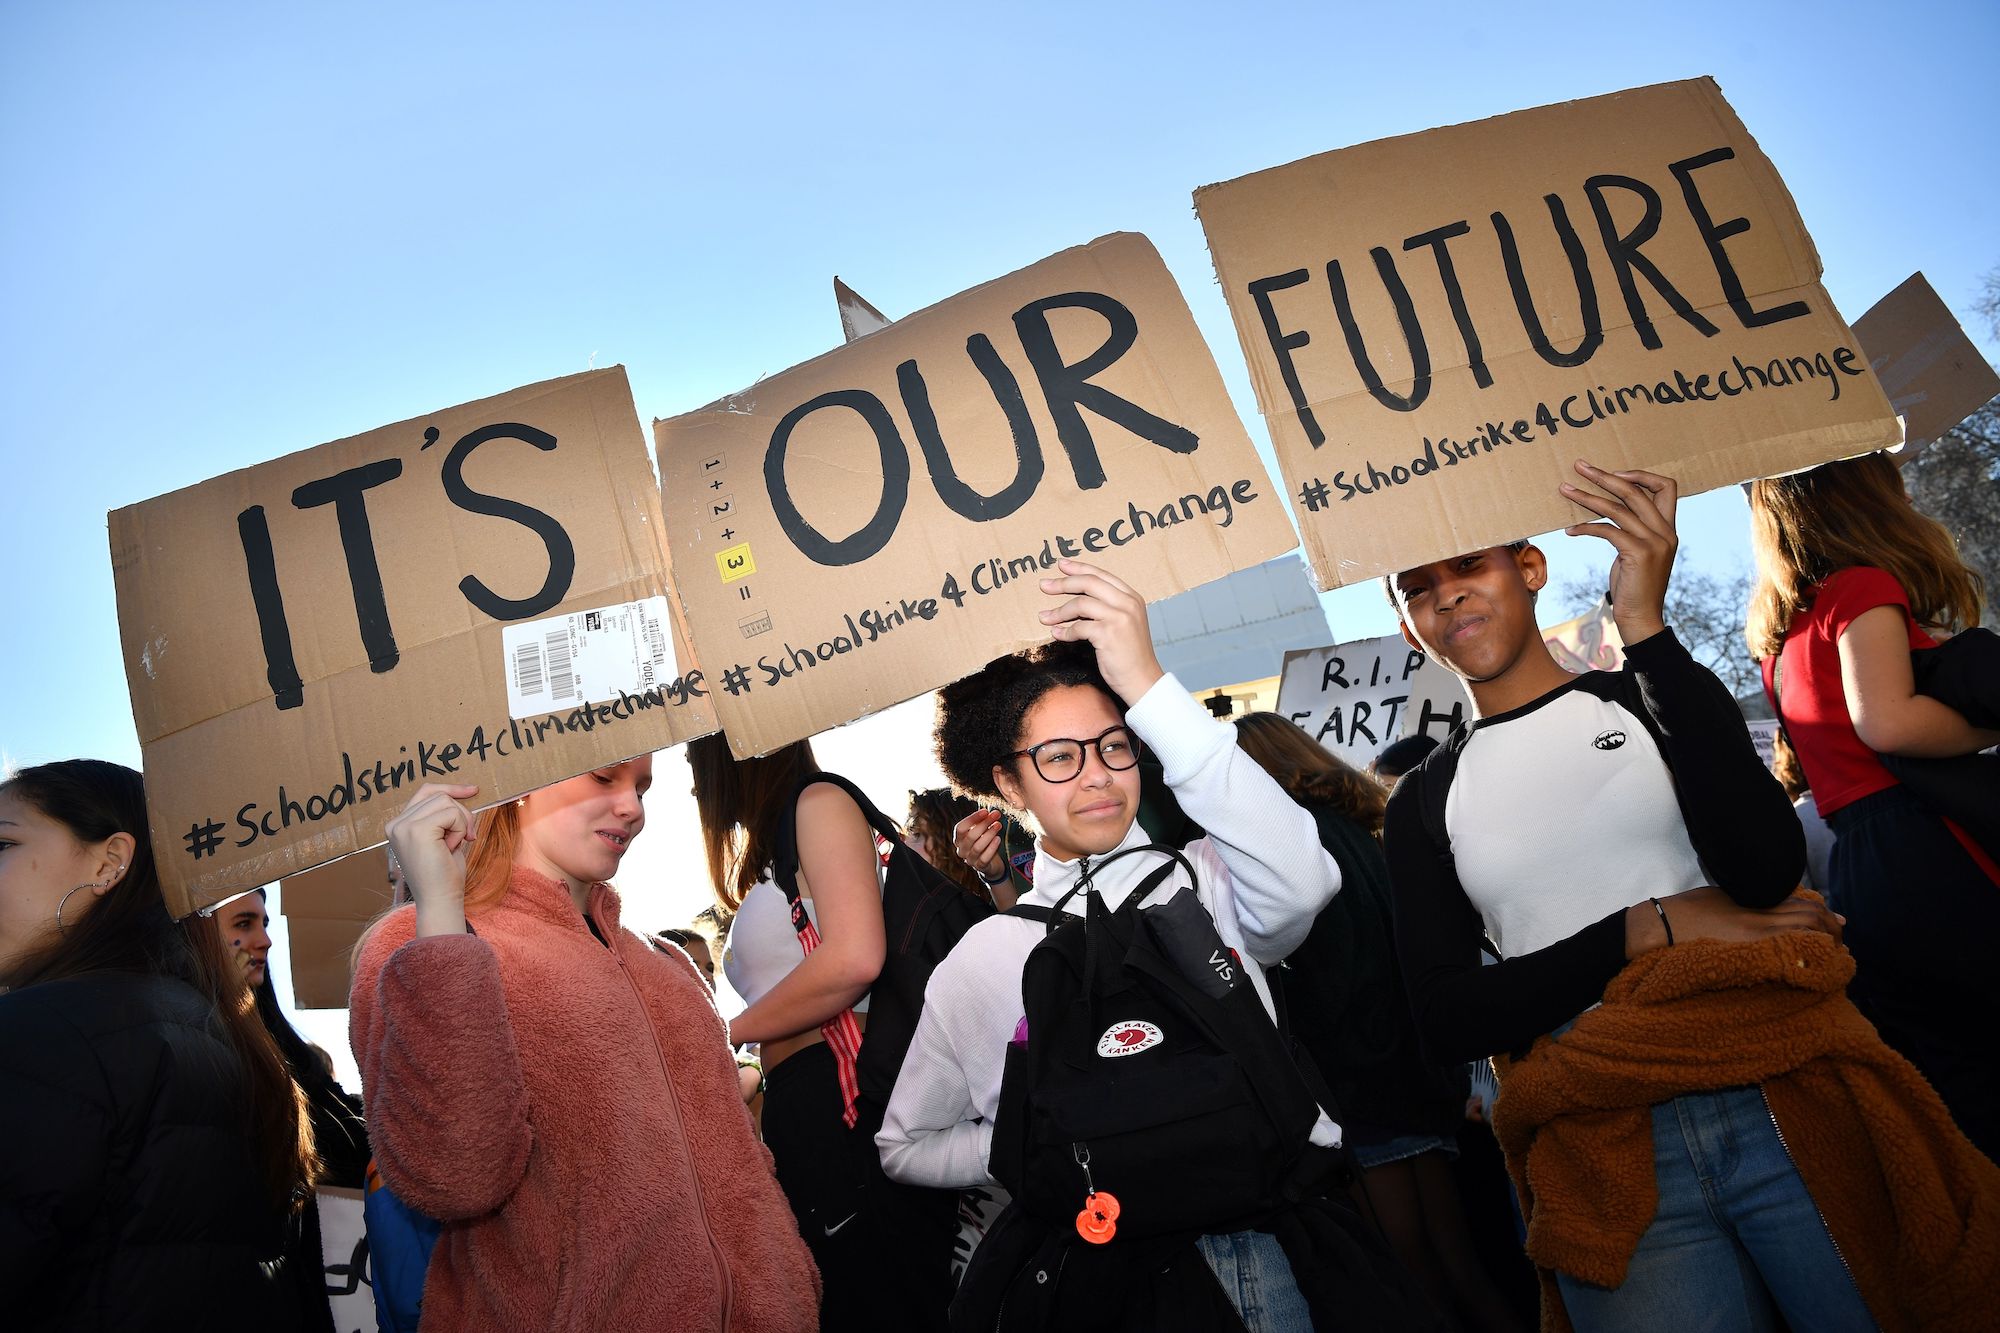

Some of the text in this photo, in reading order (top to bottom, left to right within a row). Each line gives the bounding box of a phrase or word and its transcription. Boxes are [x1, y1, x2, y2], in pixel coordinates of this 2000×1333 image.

[764, 292, 1200, 567] OUR
[1248, 147, 1810, 449] FUTURE
[238, 423, 575, 710] IT'S
[642, 660, 655, 688] YODEL
